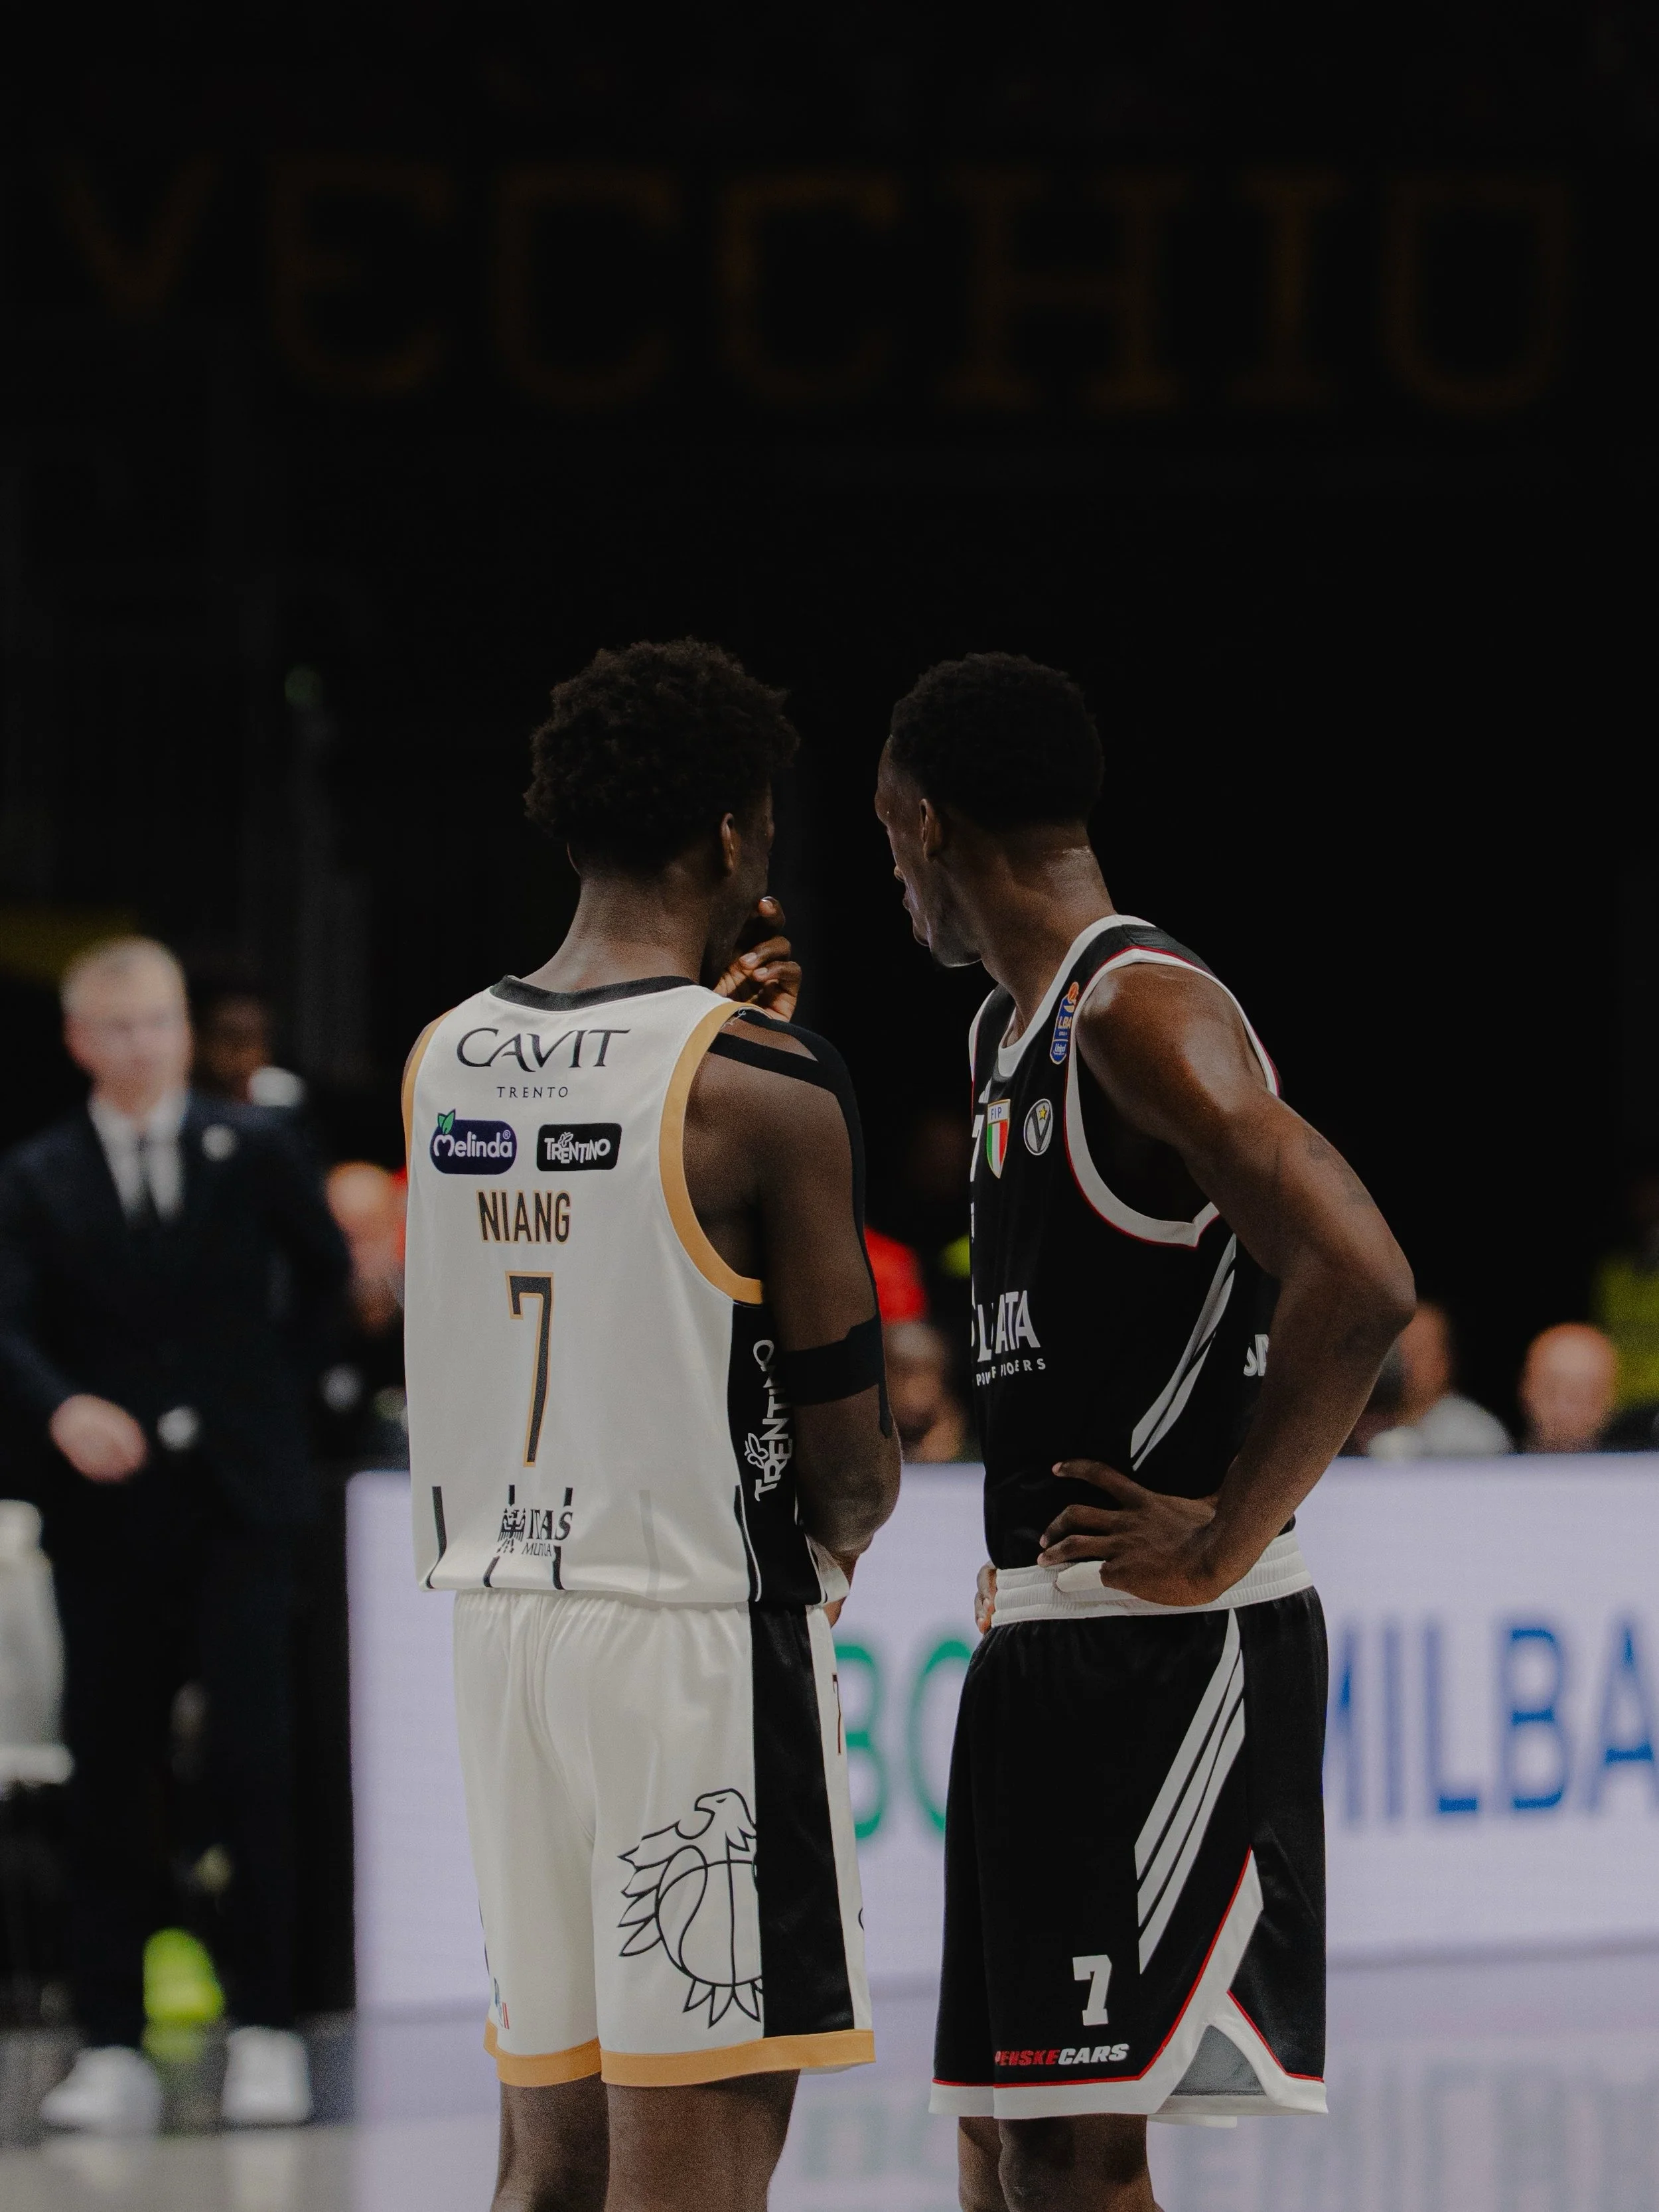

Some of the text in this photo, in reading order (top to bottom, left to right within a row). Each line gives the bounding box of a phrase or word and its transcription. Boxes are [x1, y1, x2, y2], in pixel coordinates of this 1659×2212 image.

[55, 149, 1576, 419] VECCHIO
[457, 1027, 630, 1072] CAVIT
[496, 1086, 569, 1098] TRENTO
[989, 1107, 1003, 1120] FIP
[544, 1138, 611, 1164] TRENTINO
[476, 1189, 572, 1244] NIANG
[505, 1271, 554, 1468] 7
[1072, 1954, 1113, 2026] 7
